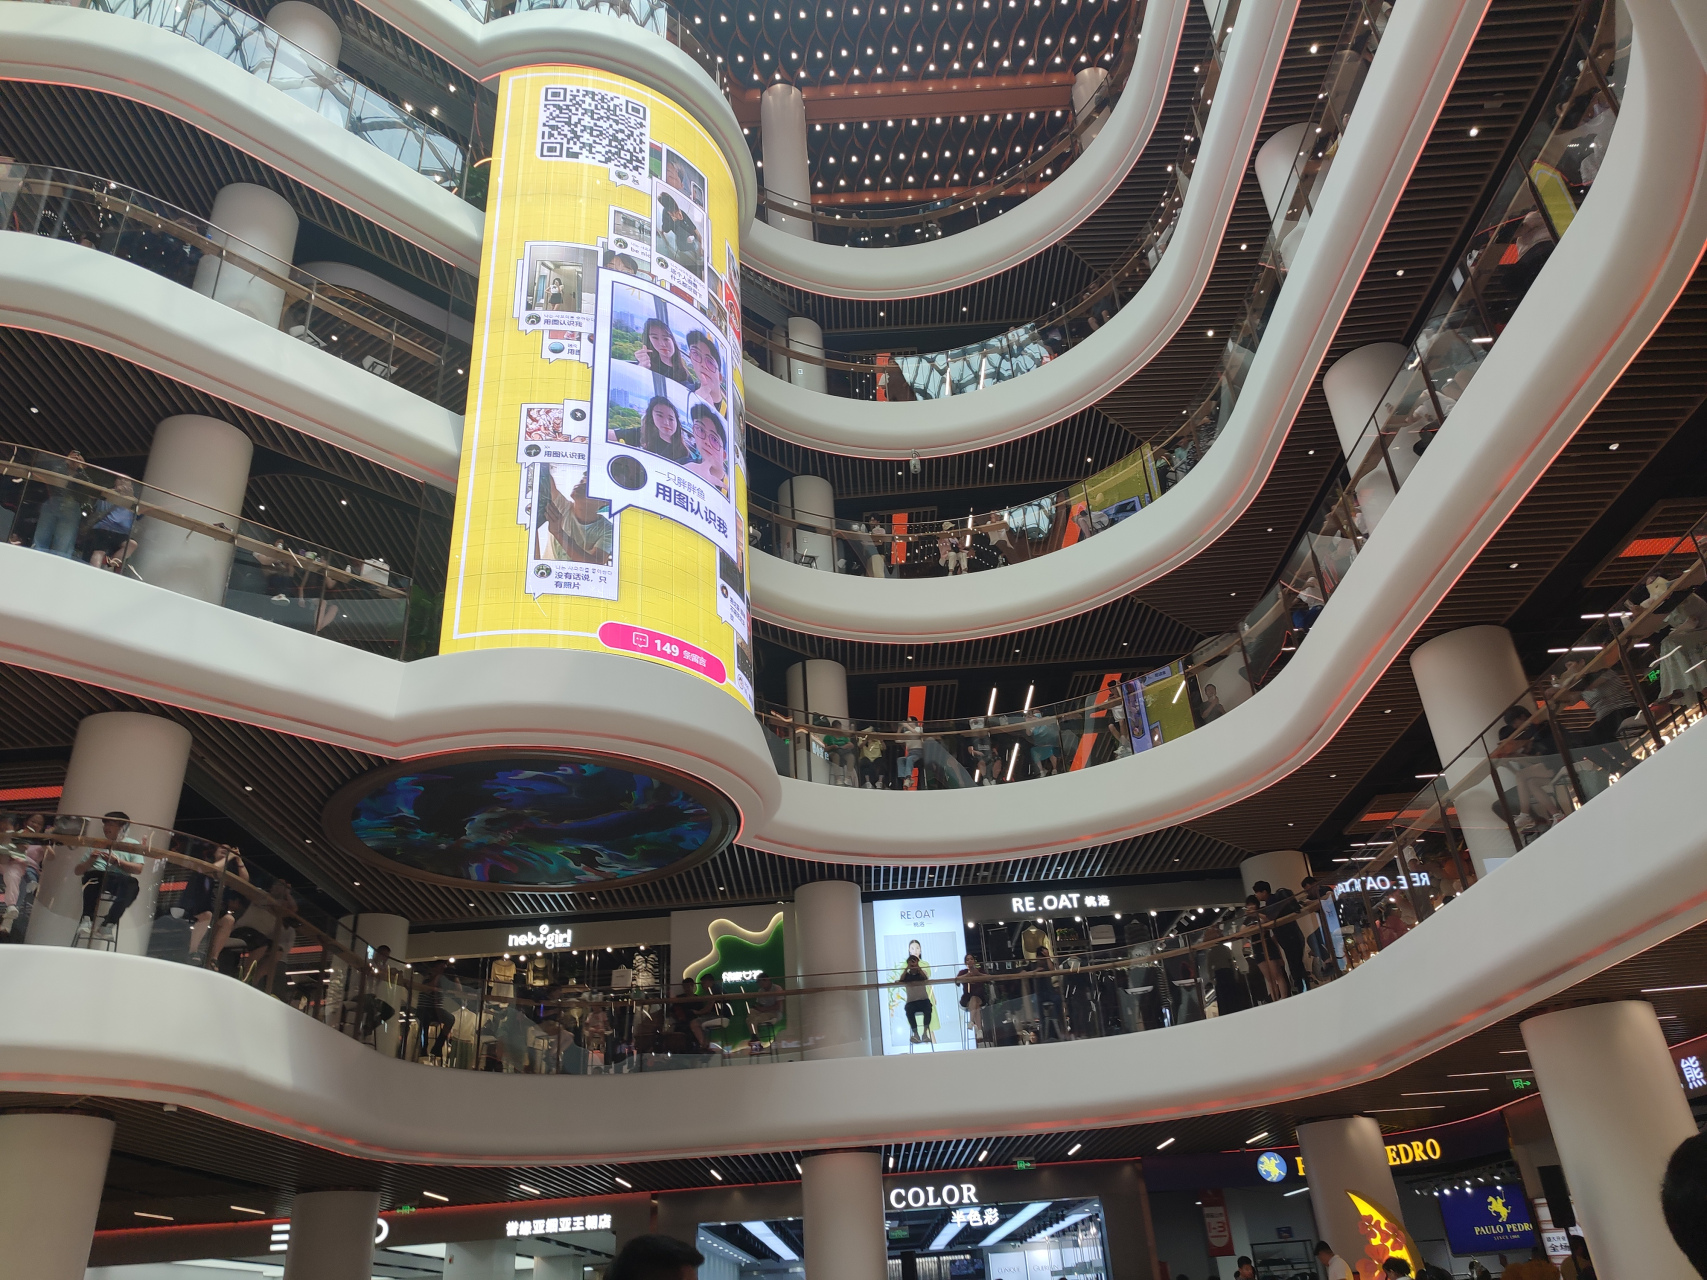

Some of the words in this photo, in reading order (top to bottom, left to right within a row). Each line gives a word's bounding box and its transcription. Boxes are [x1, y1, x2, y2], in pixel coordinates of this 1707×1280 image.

[543, 450, 586, 460] 用图认识我
[654, 470, 706, 501] 一只胖胖鱼
[655, 481, 728, 539] 用图认识我
[554, 580, 581, 590] 有照片
[654, 639, 680, 657] 149
[682, 649, 707, 668] 条留言
[1012, 893, 1081, 912] RE.OAT
[900, 909, 936, 920] RE.OAT
[1384, 1138, 1441, 1166] EDRO
[890, 1183, 979, 1209] COLOR
[951, 1207, 1000, 1228] 半色彩
[1474, 1224, 1504, 1236] PAULO
